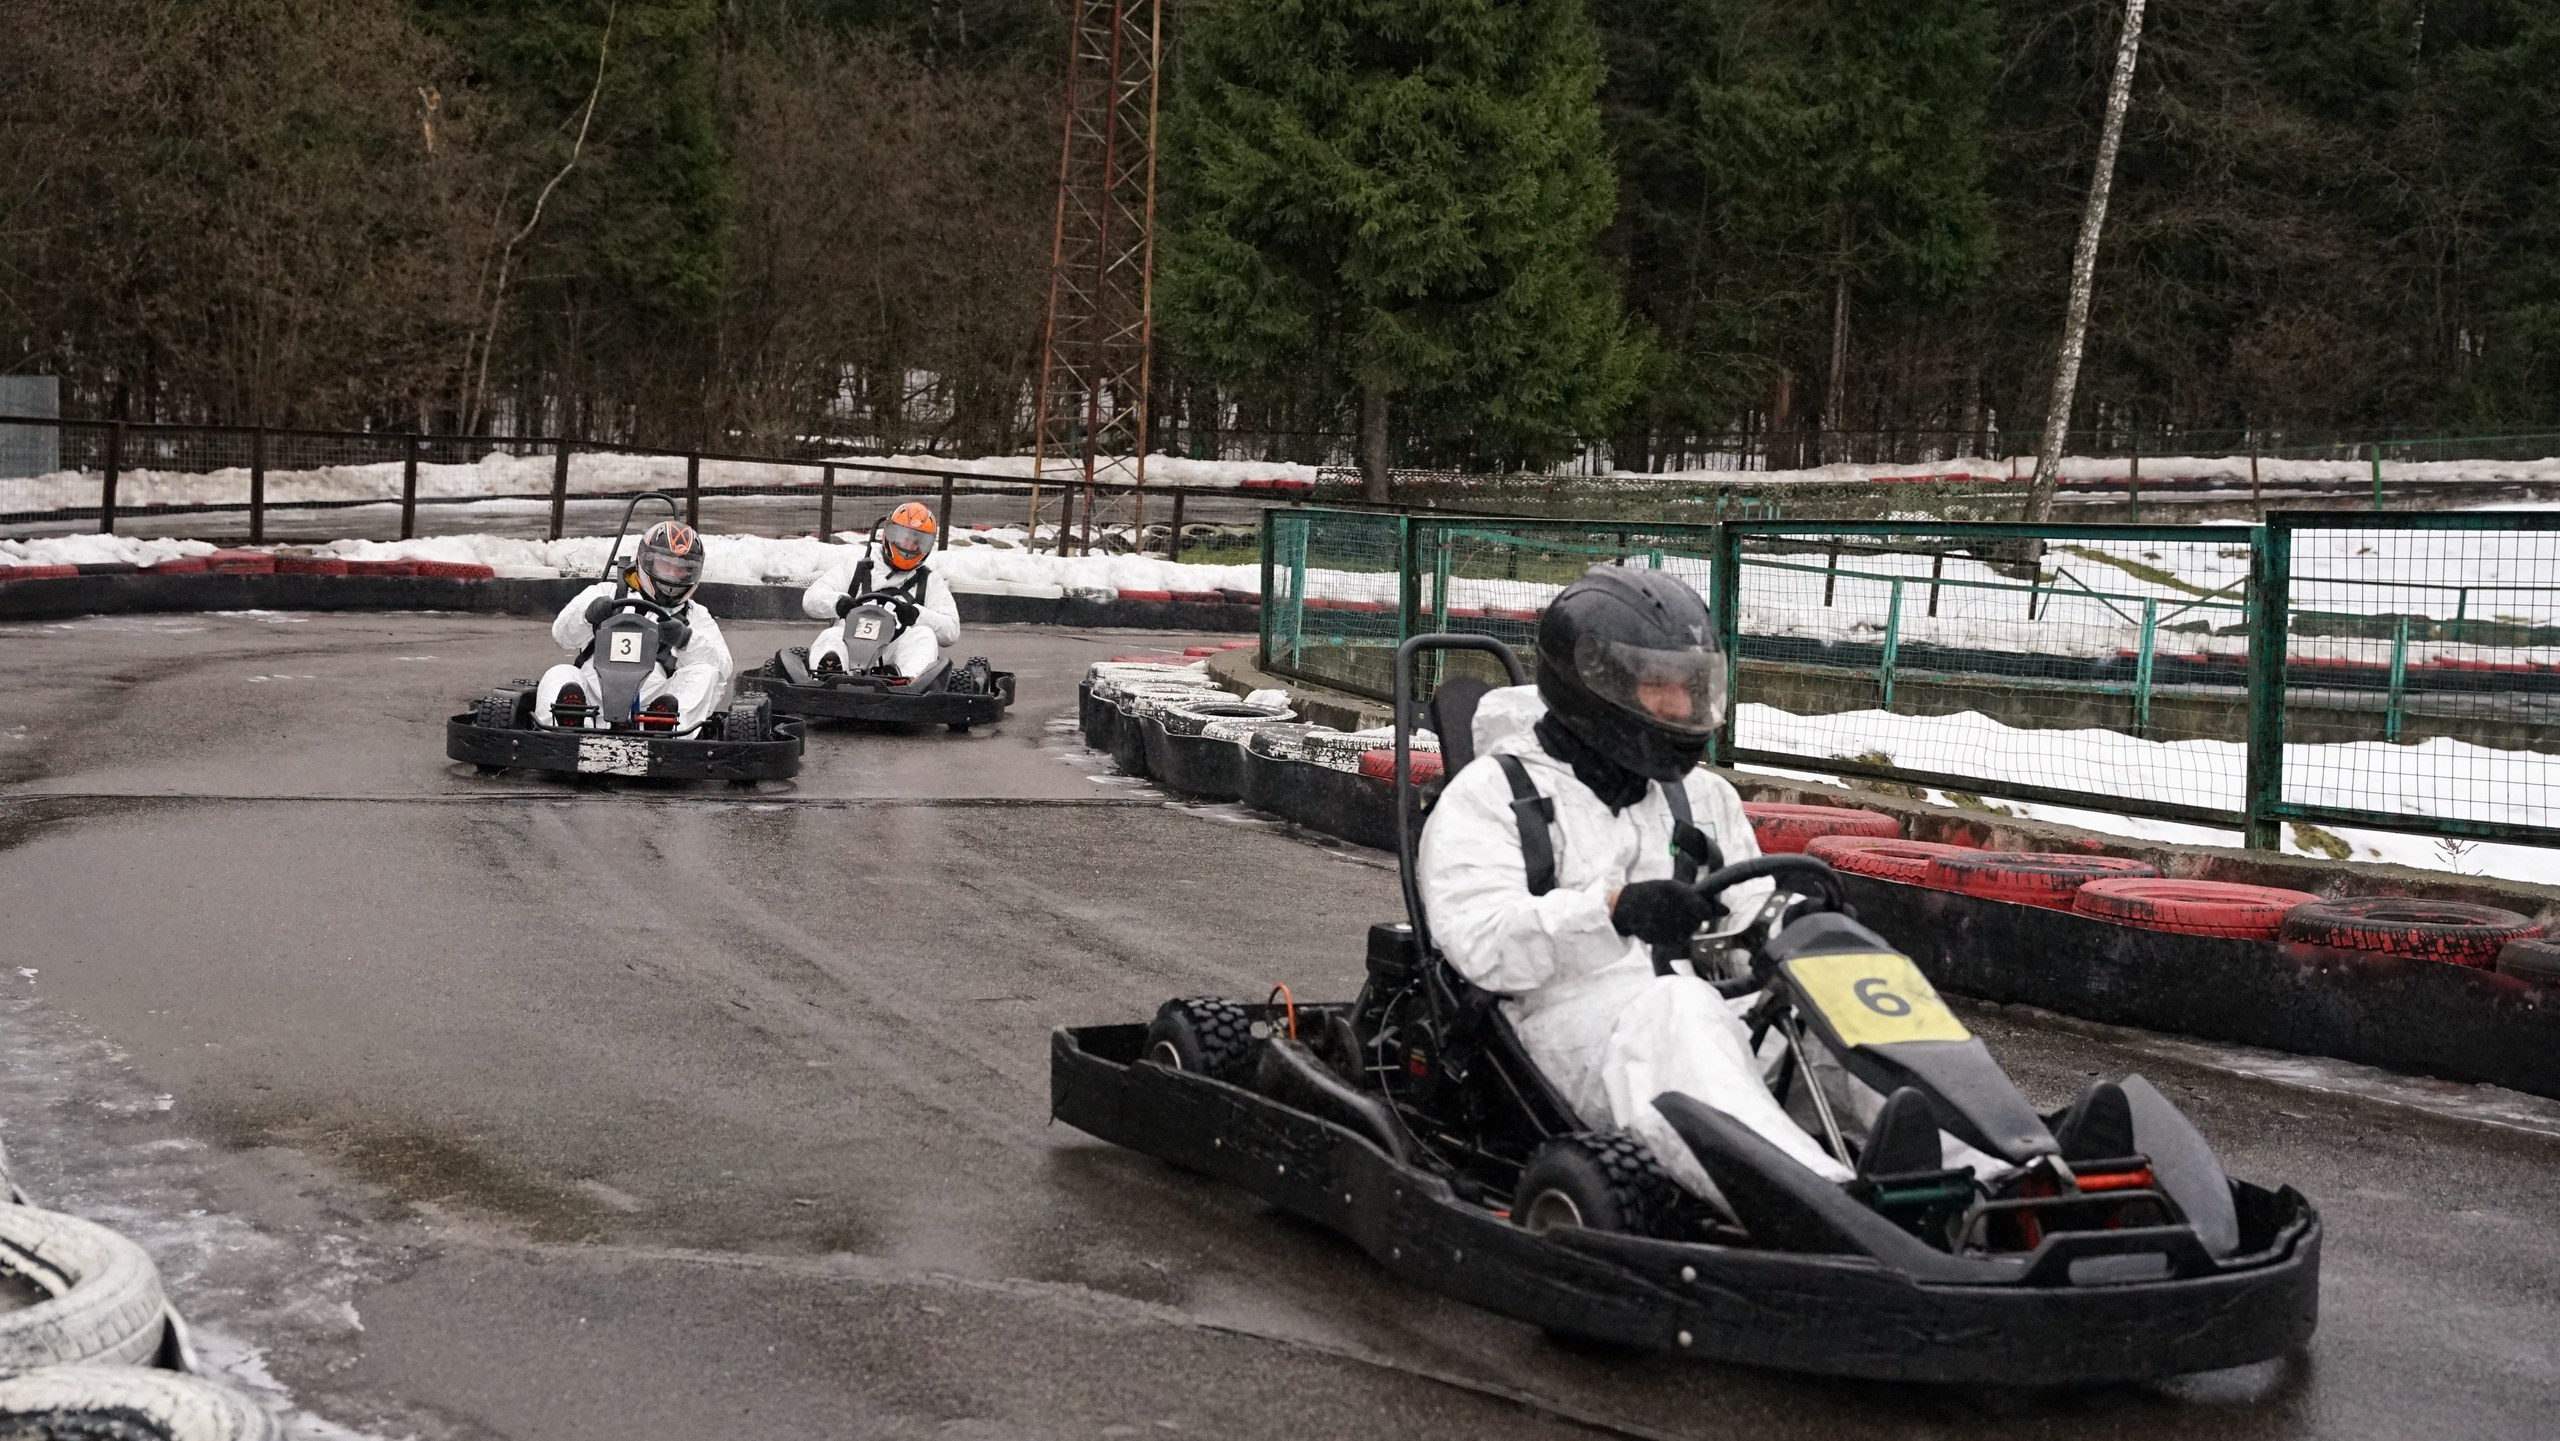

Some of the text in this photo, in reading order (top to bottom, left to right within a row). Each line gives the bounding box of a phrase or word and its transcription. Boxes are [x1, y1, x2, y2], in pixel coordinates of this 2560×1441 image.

[863, 623, 873, 634] 5
[620, 638, 632, 655] 3
[1854, 978, 1911, 1017] 6
